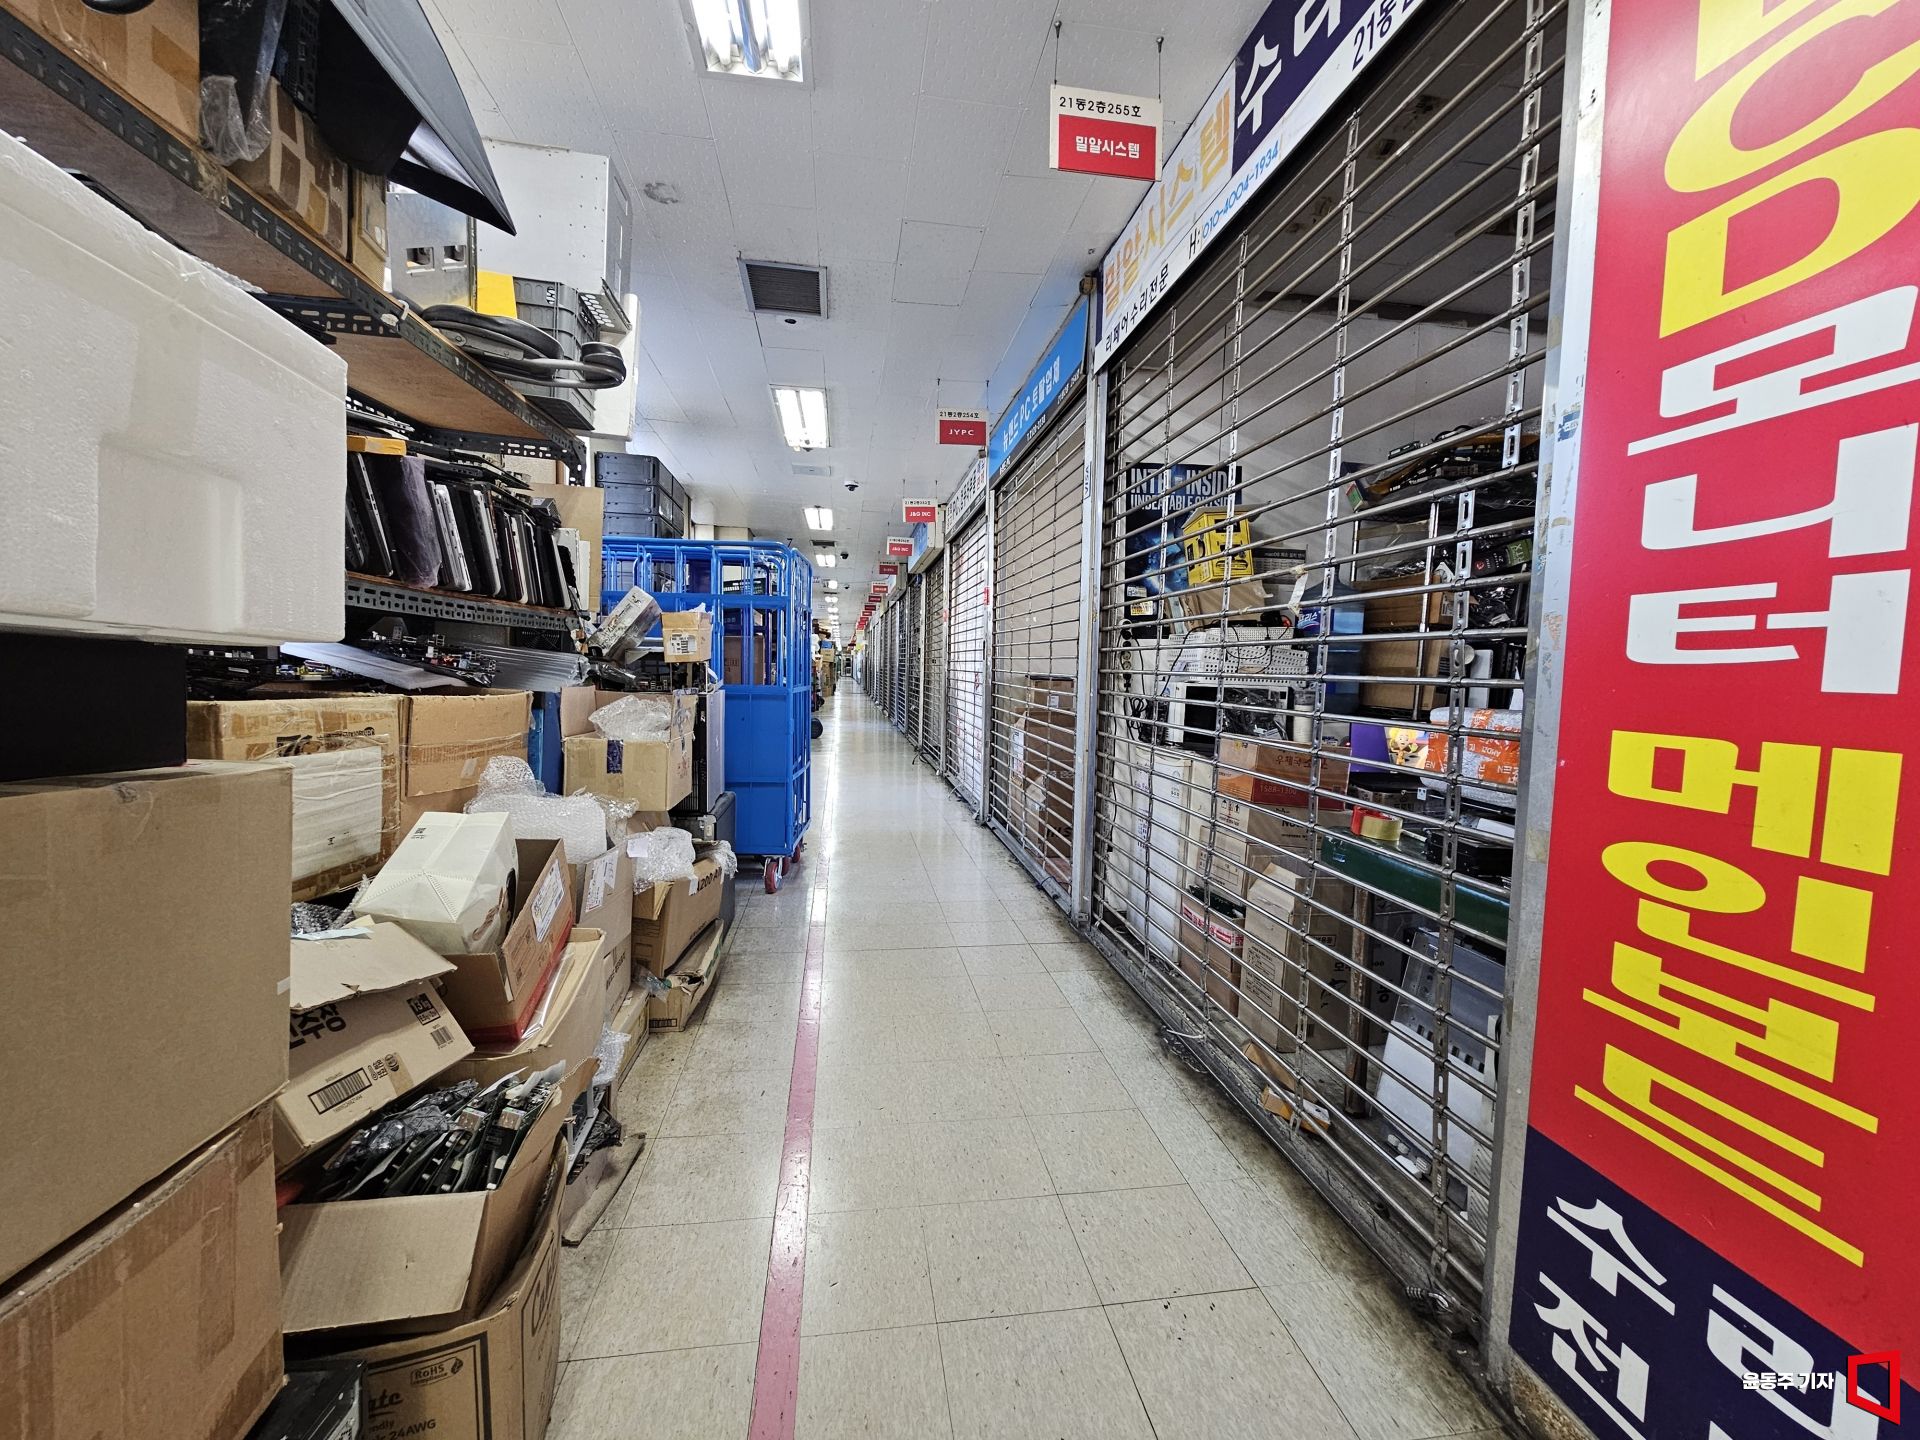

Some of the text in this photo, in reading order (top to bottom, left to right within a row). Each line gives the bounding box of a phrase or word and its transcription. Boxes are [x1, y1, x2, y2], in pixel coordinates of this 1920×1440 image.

[1059, 96, 1142, 118] 21동2층255호
[1075, 135, 1140, 159] 밀알시스템
[1105, 88, 1230, 318] 밀알시스템
[1019, 395, 1031, 429] PC
[1627, 284, 1920, 695] 모니터
[1573, 729, 1903, 1267] 메인보드
[414, 1363, 445, 1380] RoHS
